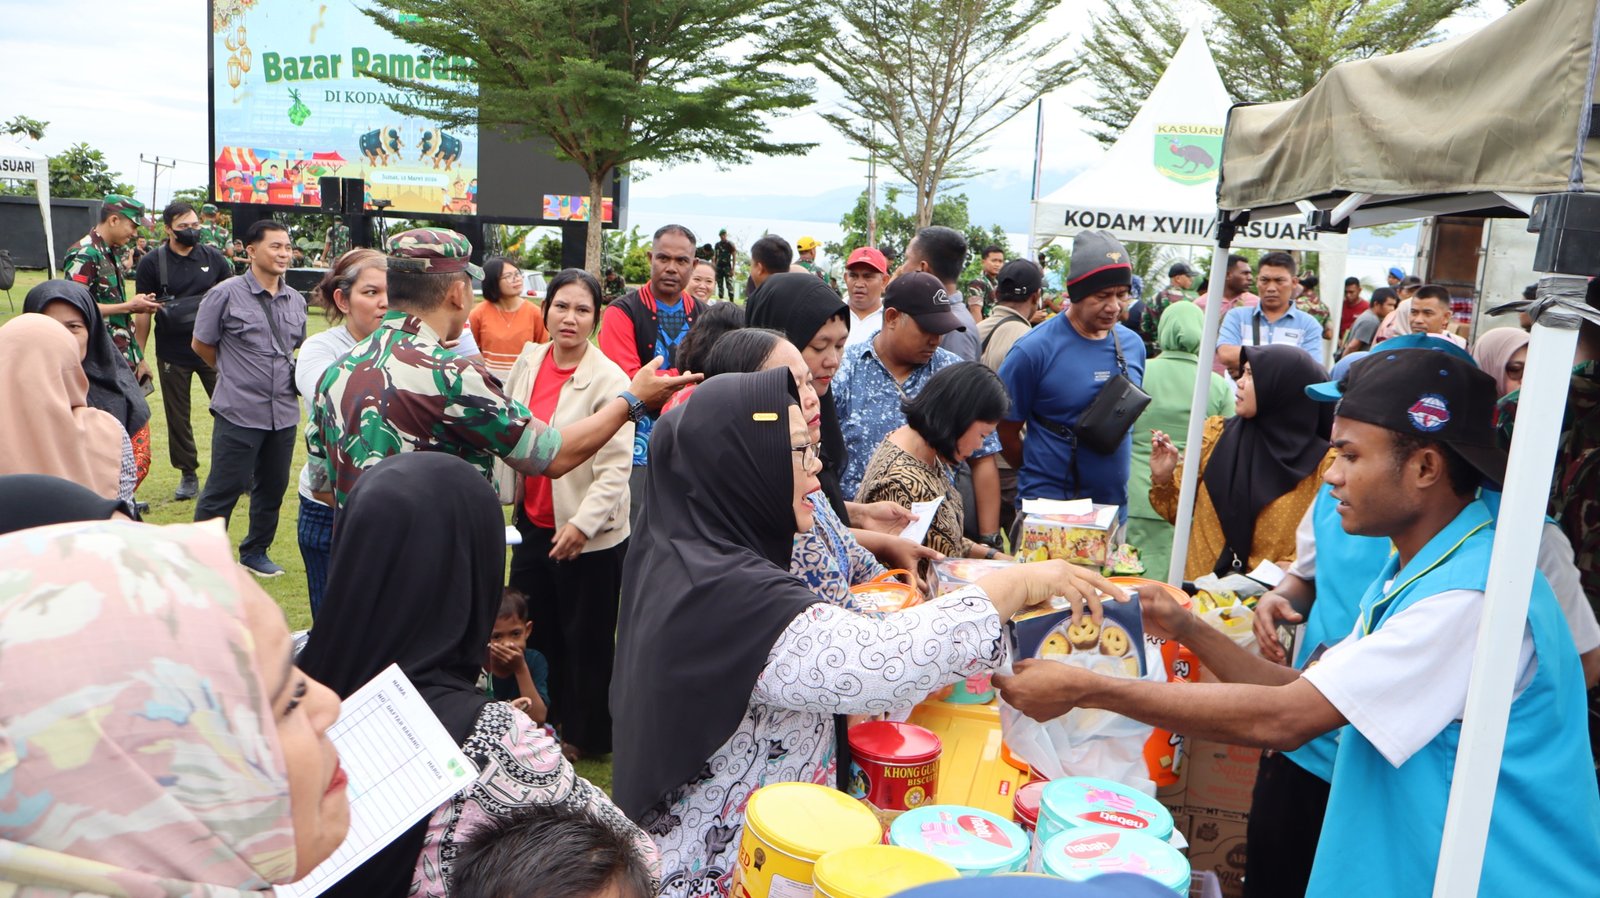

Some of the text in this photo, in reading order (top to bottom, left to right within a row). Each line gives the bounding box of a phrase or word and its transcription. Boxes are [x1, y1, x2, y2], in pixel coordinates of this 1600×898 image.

[262, 52, 342, 83] Bazar
[325, 90, 341, 102] DI
[345, 91, 399, 104] KODAM
[1158, 125, 1223, 135] KASUARI
[0, 159, 35, 173] SUARI
[1064, 210, 1146, 231] KODAM
[883, 766, 920, 779] KHONG
